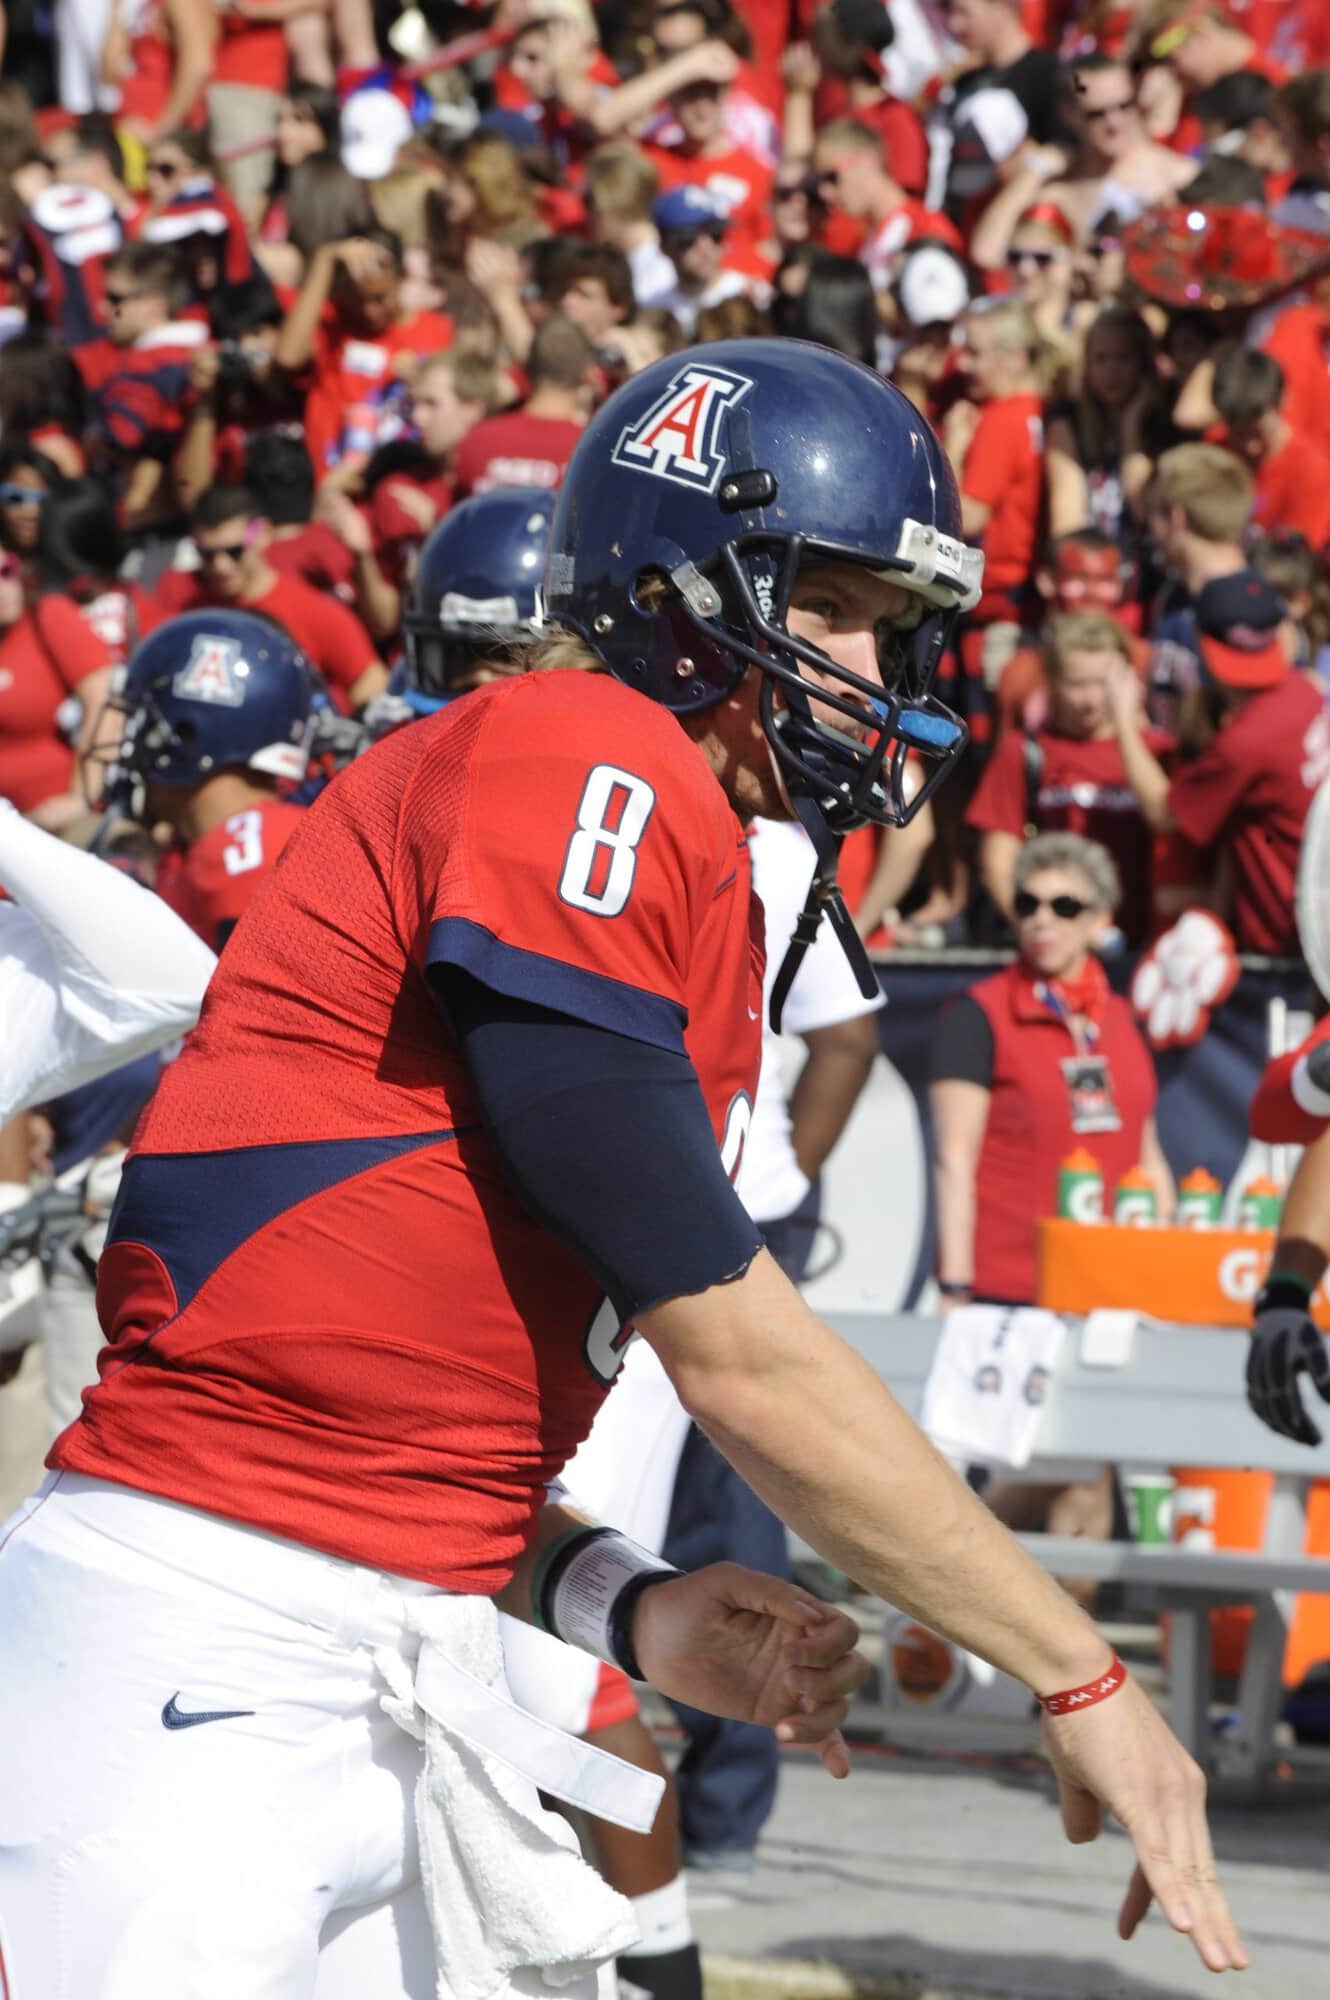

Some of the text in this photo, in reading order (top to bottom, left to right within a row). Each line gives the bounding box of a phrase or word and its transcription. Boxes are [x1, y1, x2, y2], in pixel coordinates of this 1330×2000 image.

[612, 364, 753, 492] A
[173, 633, 246, 707] A
[224, 809, 262, 875] 3
[557, 763, 656, 918] 8
